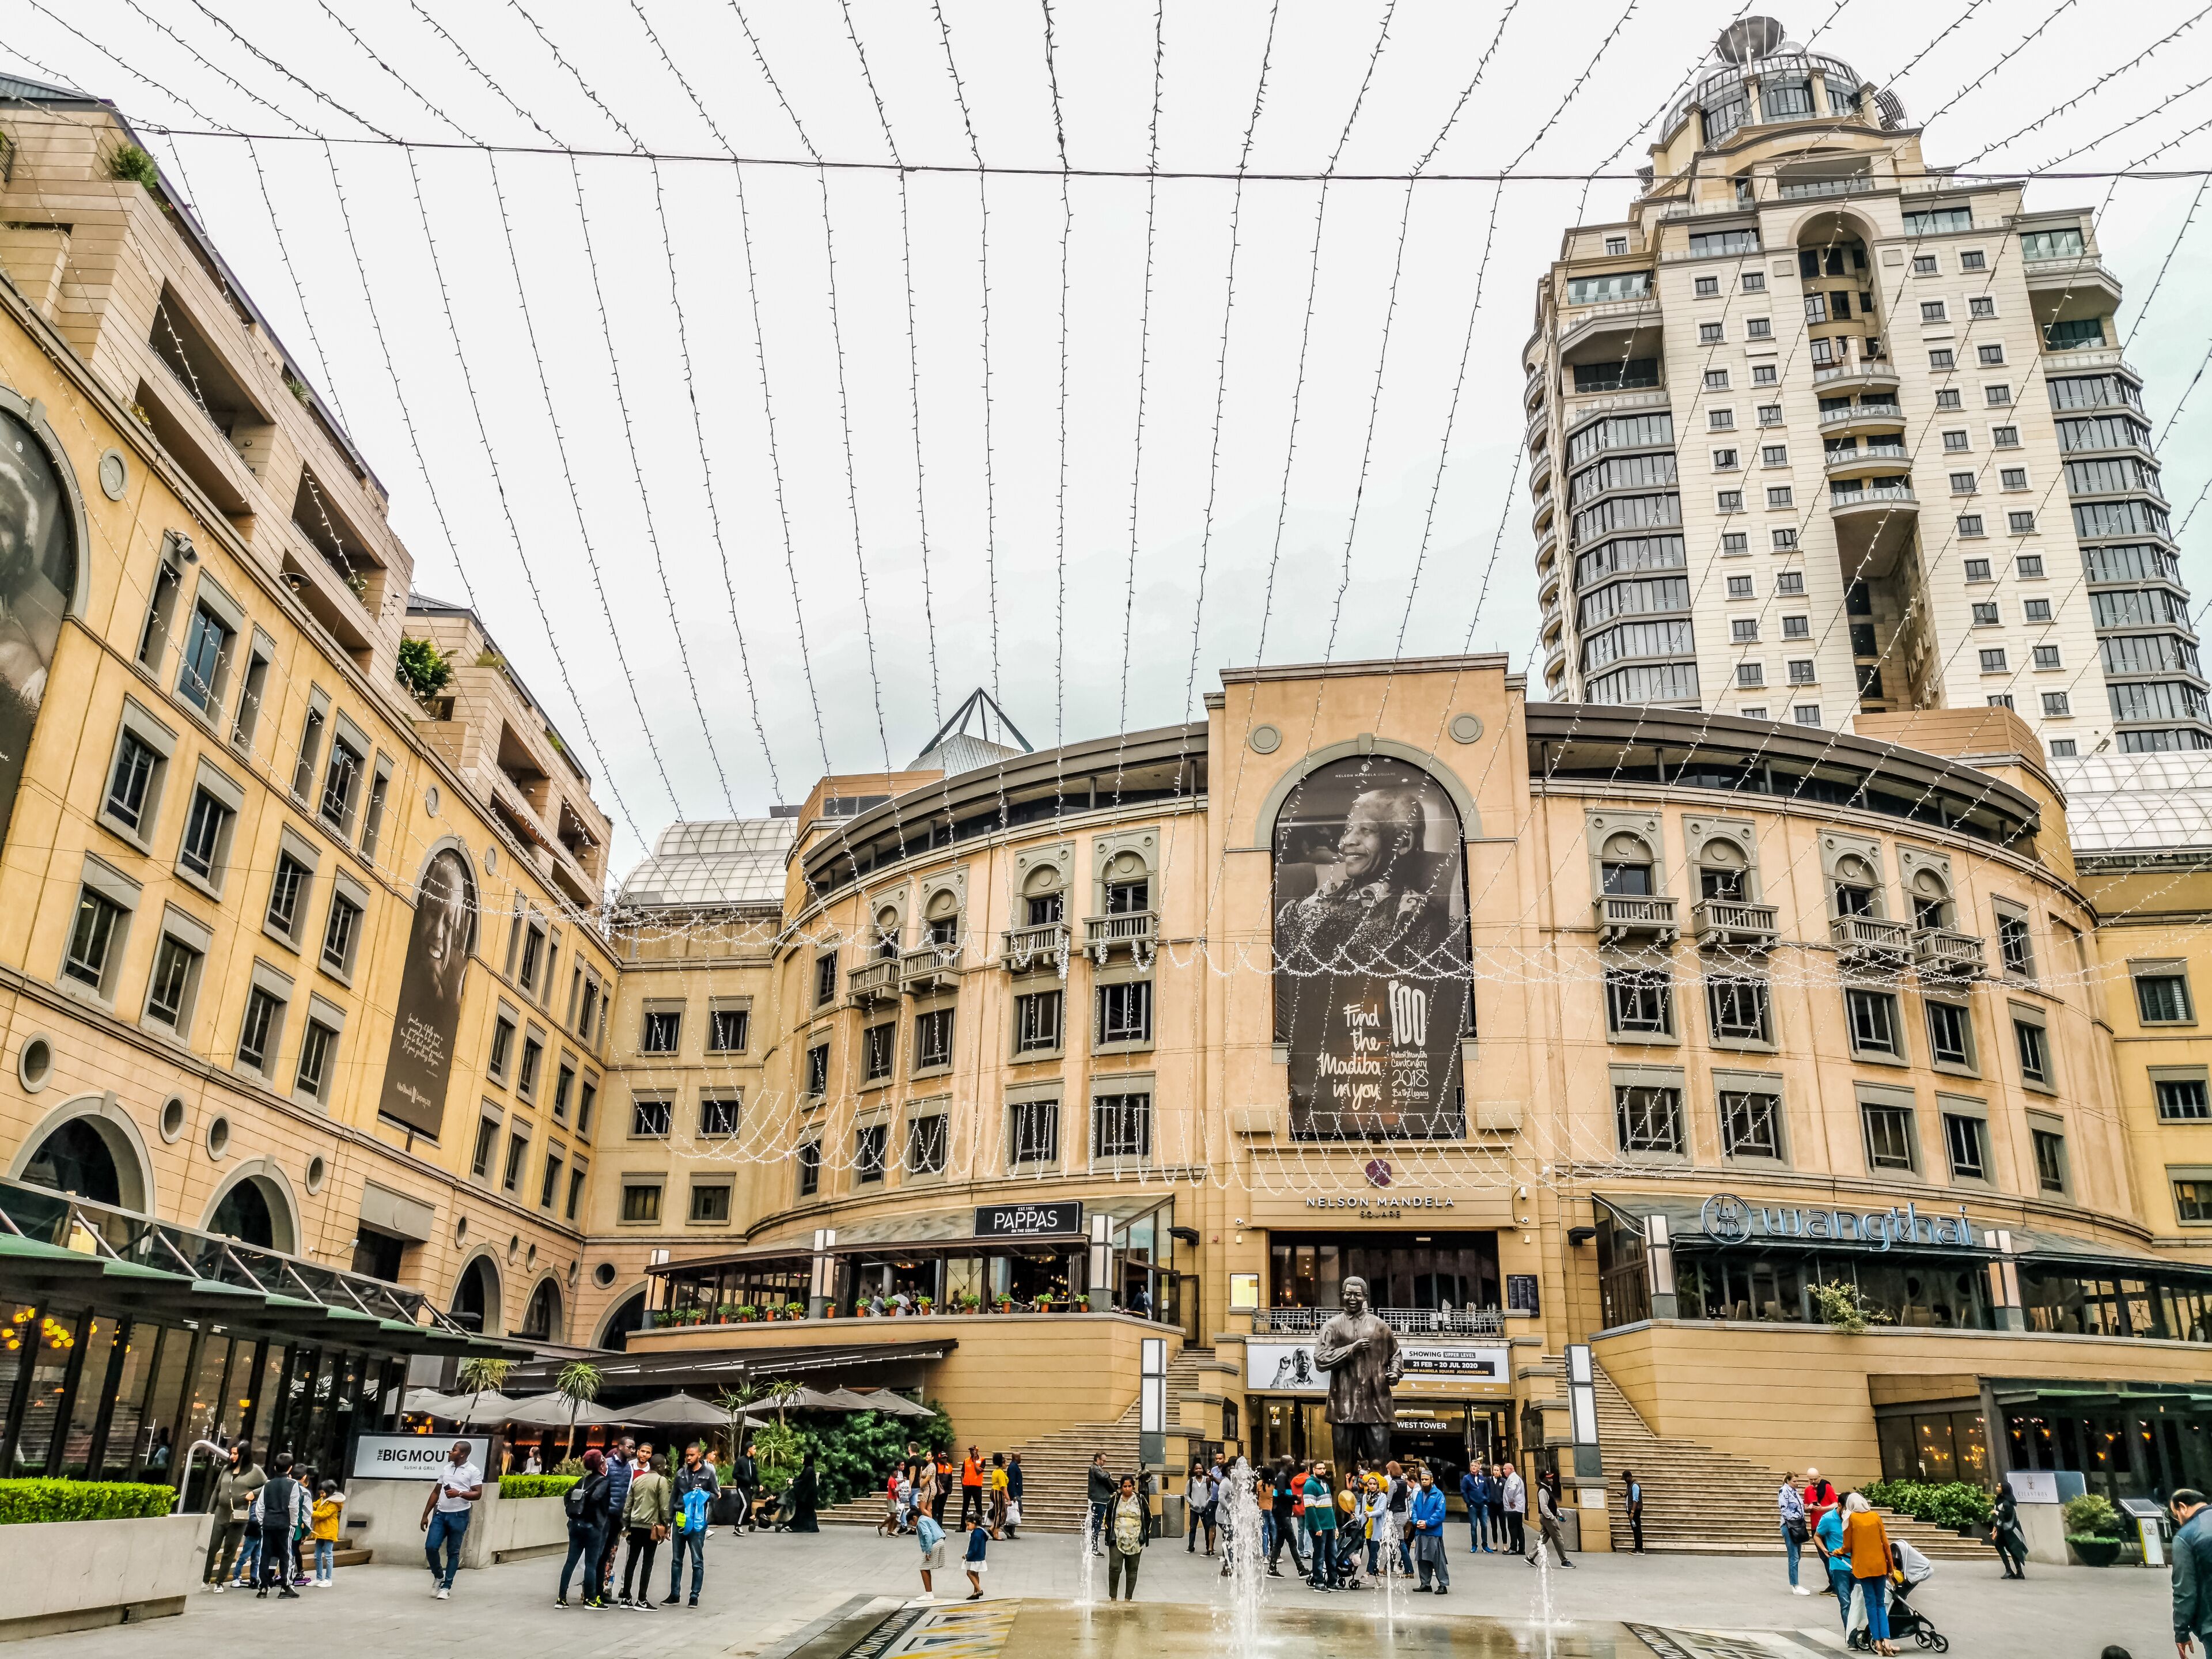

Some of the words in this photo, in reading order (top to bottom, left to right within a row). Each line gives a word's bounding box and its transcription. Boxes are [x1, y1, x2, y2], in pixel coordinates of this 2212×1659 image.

[1343, 1003, 1380, 1027] Find
[1388, 980, 1426, 1047] 100
[1350, 1027, 1381, 1052] the
[1317, 1052, 1381, 1077] Madiba
[1392, 1069, 1429, 1087] 2018
[1333, 1079, 1351, 1097] in
[1353, 1083, 1382, 1110] you
[1306, 1196, 1369, 1208] NELSON
[1376, 1196, 1455, 1207] MANDELA
[1359, 1210, 1401, 1218] SQUARE
[994, 1210, 1058, 1229] PAPPAS
[1762, 1202, 1973, 1252] wangthai
